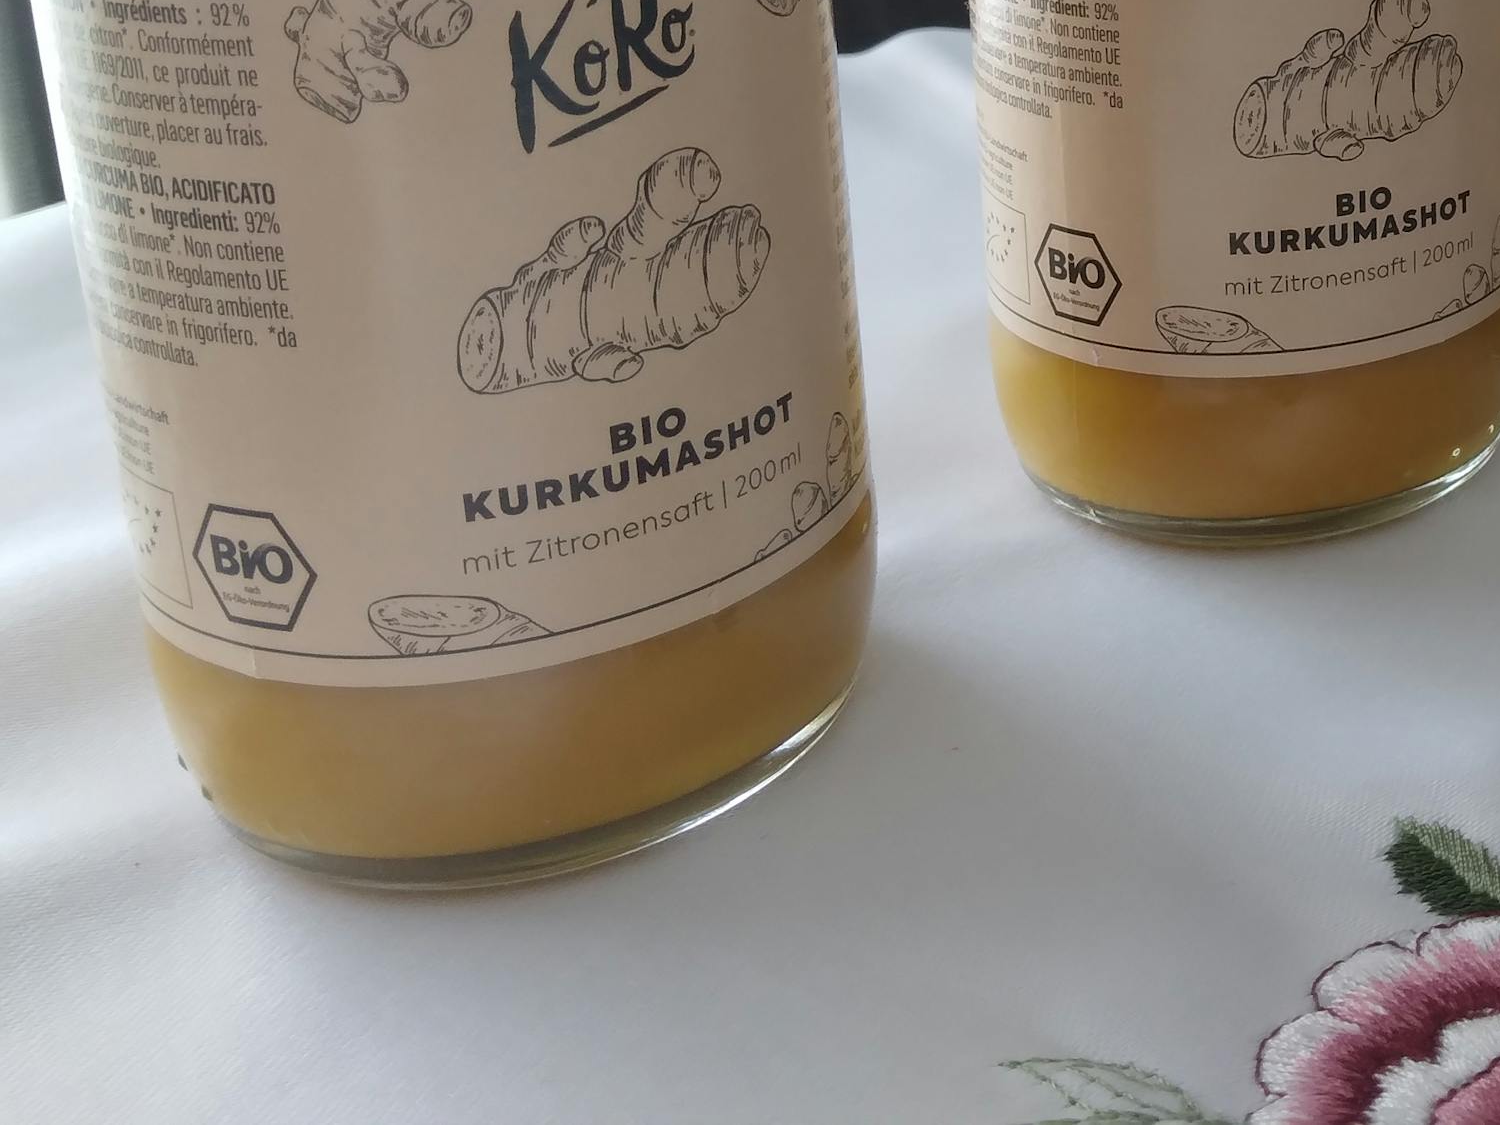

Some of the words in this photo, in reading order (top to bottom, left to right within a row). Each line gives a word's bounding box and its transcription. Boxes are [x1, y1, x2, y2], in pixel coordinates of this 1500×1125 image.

[138, 28, 254, 57] Conformément
[1050, 19, 1069, 37] Non
[1072, 25, 1120, 44] contiene
[1037, 36, 1101, 64] Regolamento
[1105, 48, 1121, 65] UE
[153, 64, 170, 84] ce
[176, 64, 232, 88] produit
[238, 68, 259, 87] ne
[1014, 52, 1066, 80] temperatura
[1068, 66, 1123, 88] ambiente.
[112, 82, 175, 113] Conserver
[190, 92, 262, 120] tempéra-
[1043, 80, 1096, 107] frigorifero.
[157, 116, 199, 144] placer
[205, 126, 222, 145] au
[226, 124, 268, 147] frais.
[141, 173, 169, 200] BIO,
[172, 177, 275, 205] ACIDIFICATO
[1336, 186, 1392, 217] BIO
[151, 202, 239, 233] Ingredienti:
[1229, 190, 1471, 256] KURKUMASHOT
[184, 235, 212, 259] Non
[217, 242, 284, 263] contiene
[167, 260, 261, 291] Regolamento
[266, 269, 289, 291] UE
[1225, 277, 1263, 296] mit
[1270, 257, 1407, 294] Zitronensaft
[136, 282, 213, 315] temperatura
[217, 296, 294, 320] ambiente.
[182, 318, 258, 347] frigorifero.
[609, 407, 687, 454] BIO
[463, 392, 793, 522] KURKUMASHOT
[463, 544, 517, 575] mit
[527, 489, 714, 564] Zitronensaft
